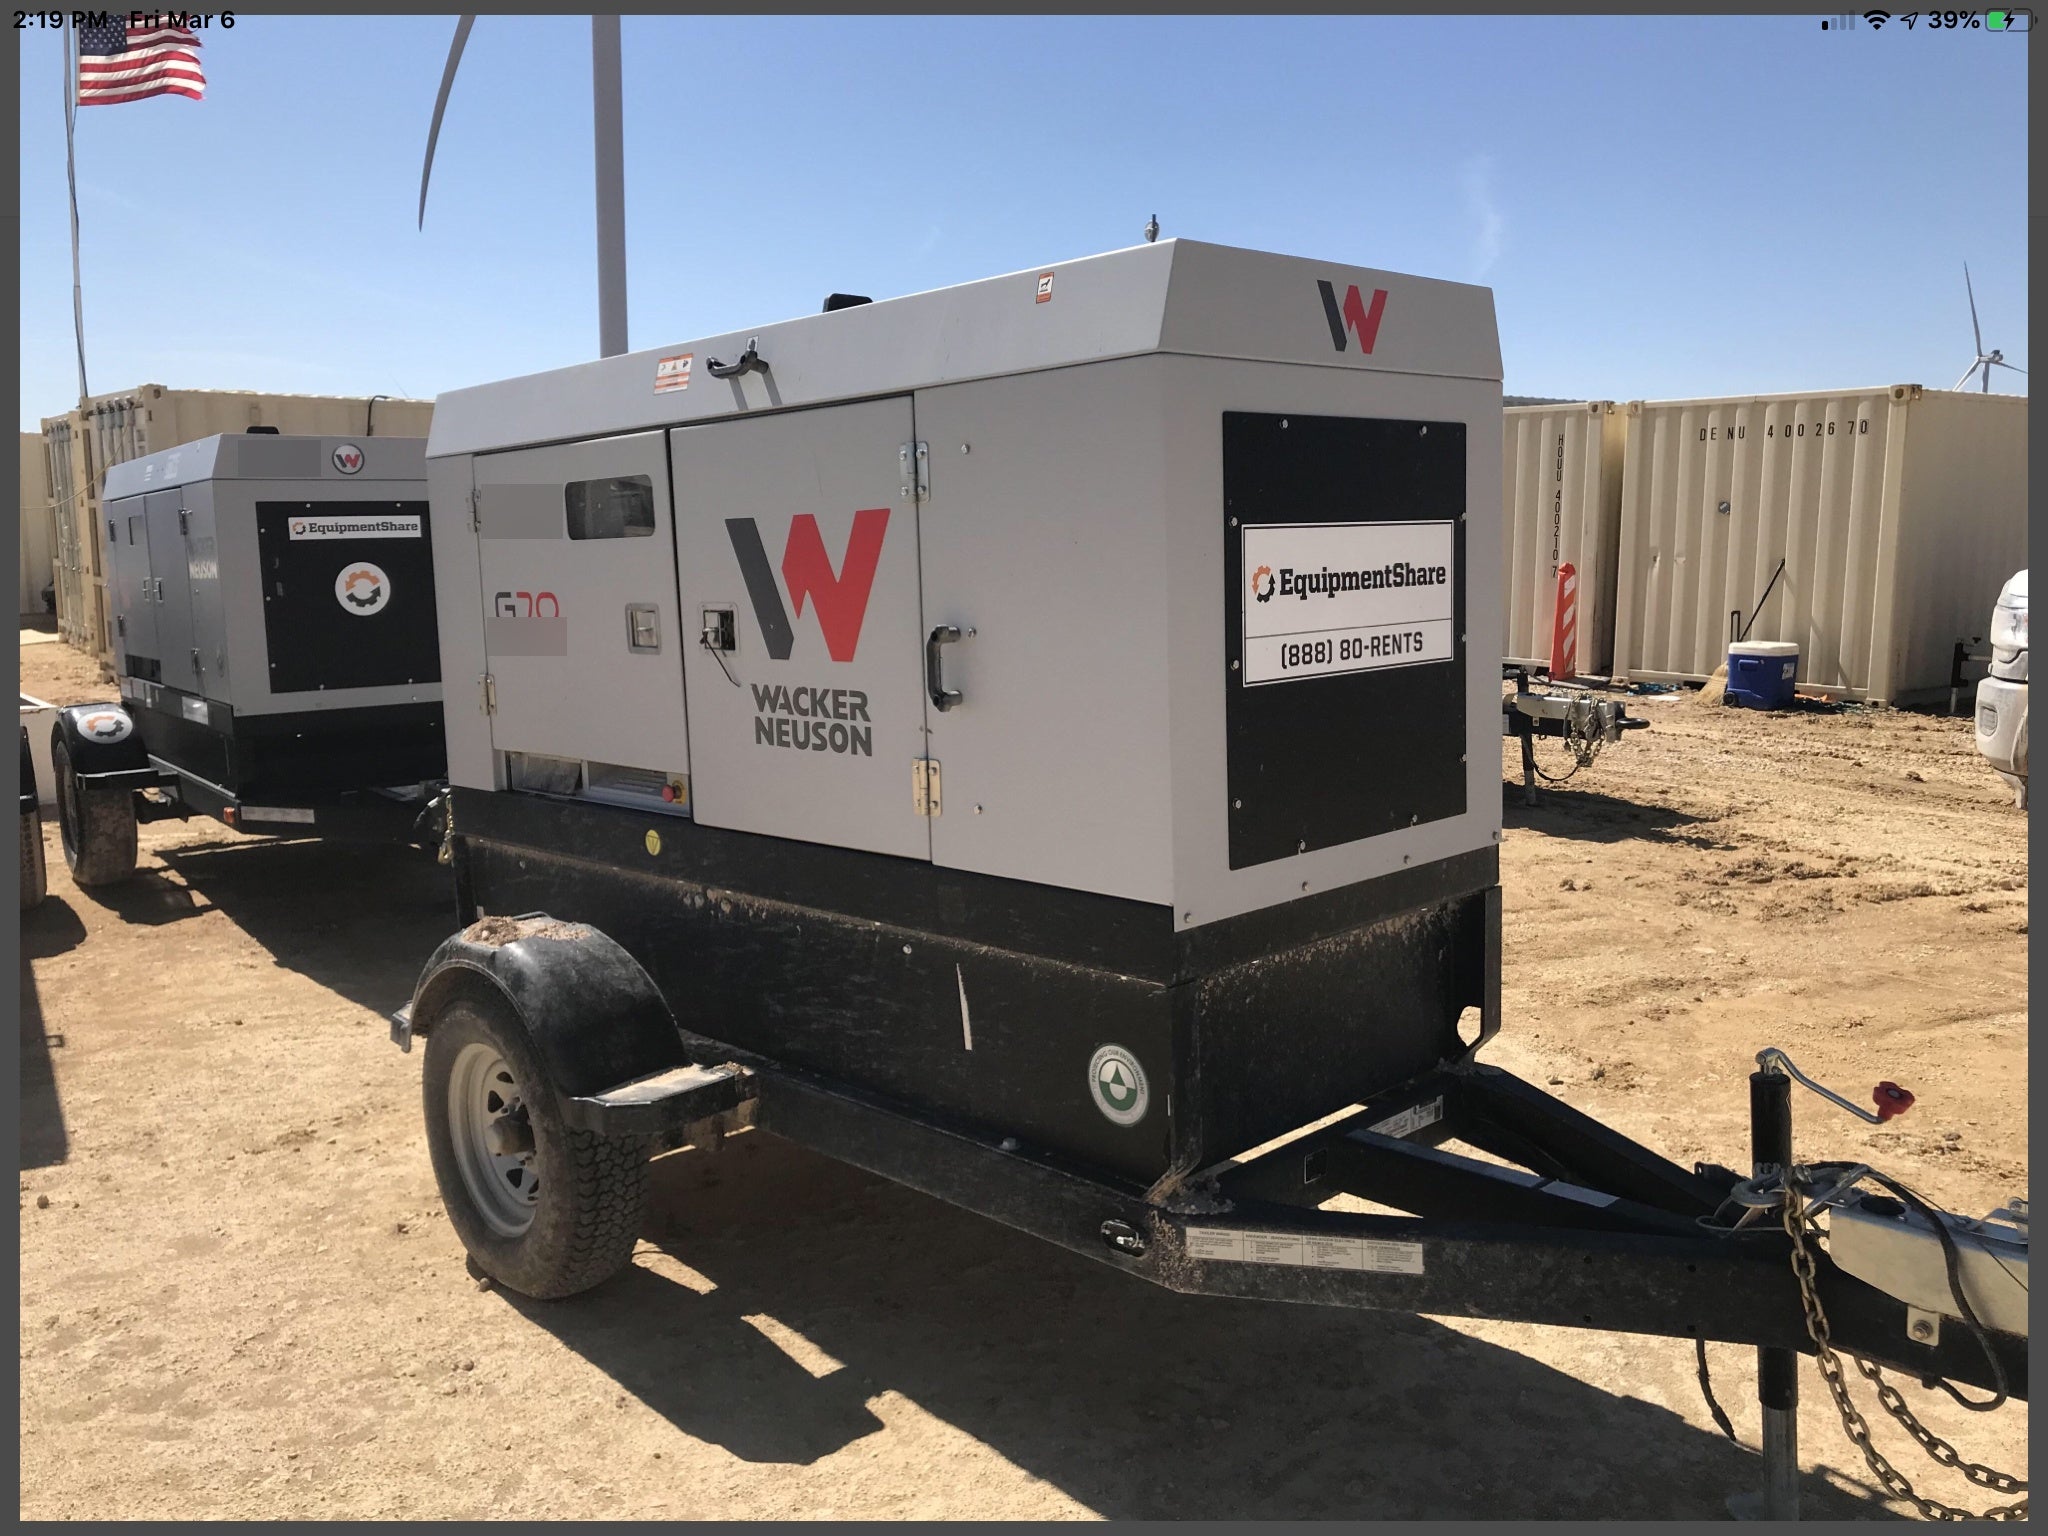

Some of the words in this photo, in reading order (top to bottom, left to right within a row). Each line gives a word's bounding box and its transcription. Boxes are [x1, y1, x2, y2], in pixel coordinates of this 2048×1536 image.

[1556, 433, 1564, 481] HOUU
[309, 521, 418, 535] EquipmentShare
[1279, 562, 1446, 600] EquipmentShare
[1281, 639, 1333, 669] (888)
[1340, 631, 1423, 660] 80-RENTS
[751, 683, 871, 722] WACKER
[754, 716, 873, 757] NEUSON
